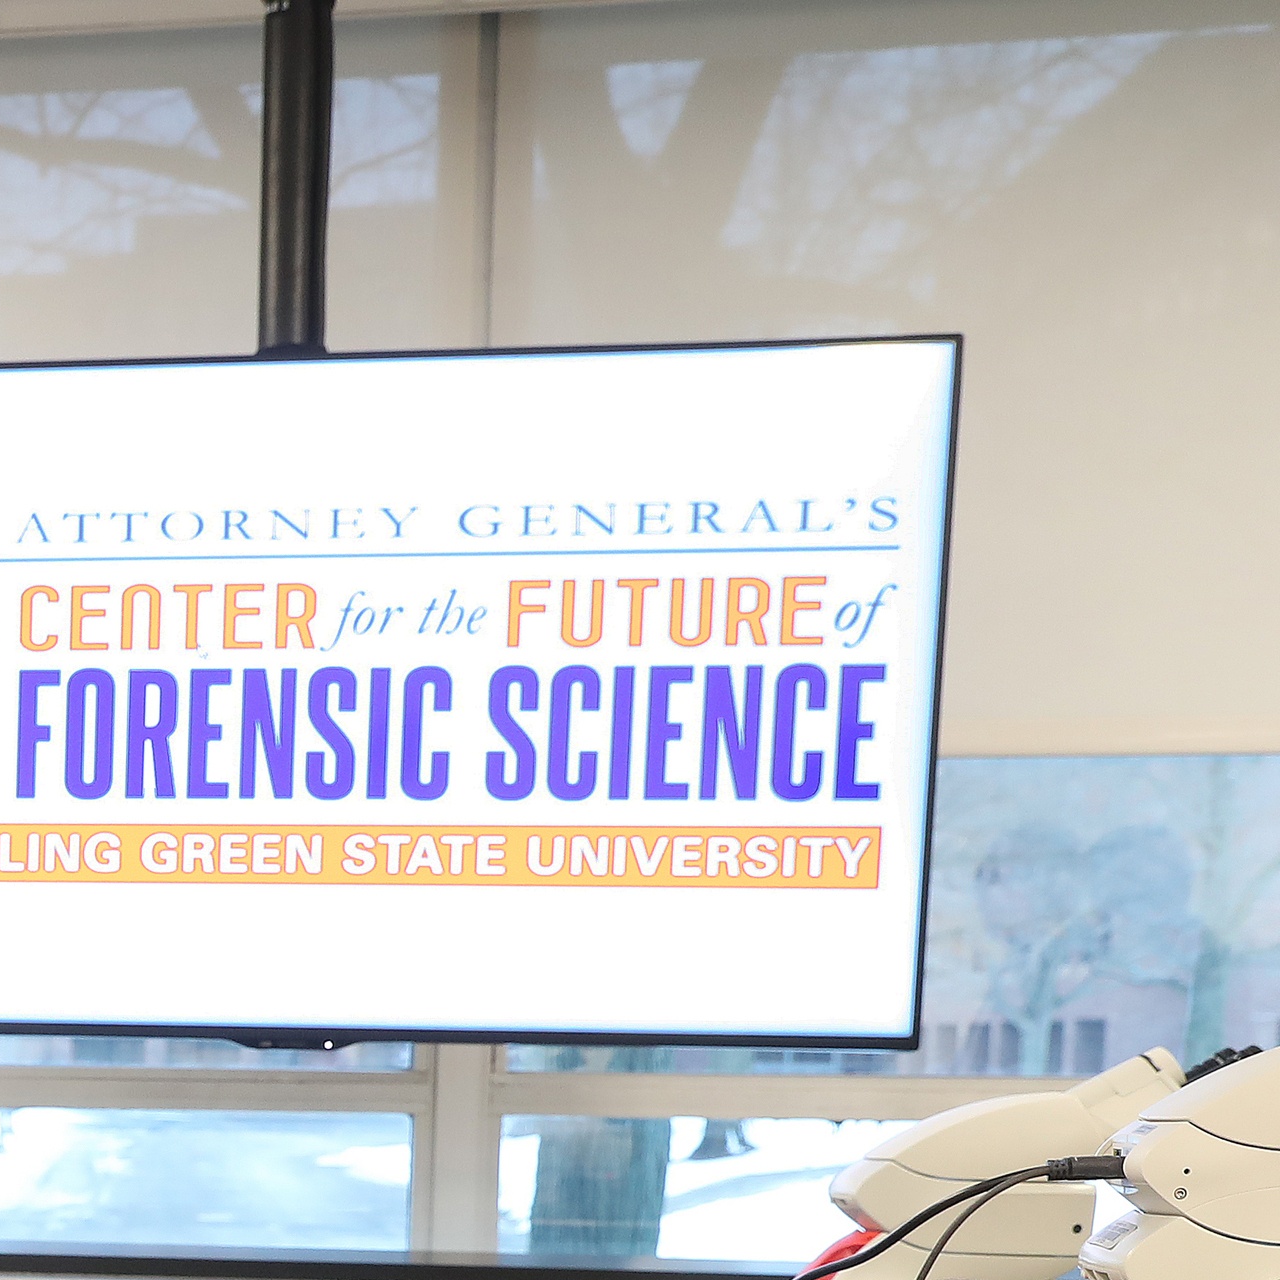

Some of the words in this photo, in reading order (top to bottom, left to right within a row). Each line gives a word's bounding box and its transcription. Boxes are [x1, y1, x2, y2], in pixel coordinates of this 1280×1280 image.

[16, 506, 420, 543] ATTORNEY
[457, 498, 899, 537] GENERAL'S
[19, 583, 317, 652] CENTER
[321, 591, 404, 651] for
[418, 588, 488, 635] the
[507, 576, 827, 648] FUTURE
[834, 584, 898, 648] of
[15, 665, 454, 802] FORENSIC
[484, 662, 888, 802] SCIENCE
[141, 832, 323, 874] GREEN
[342, 833, 506, 875] STATE
[527, 835, 871, 878] UNIVERSITY
